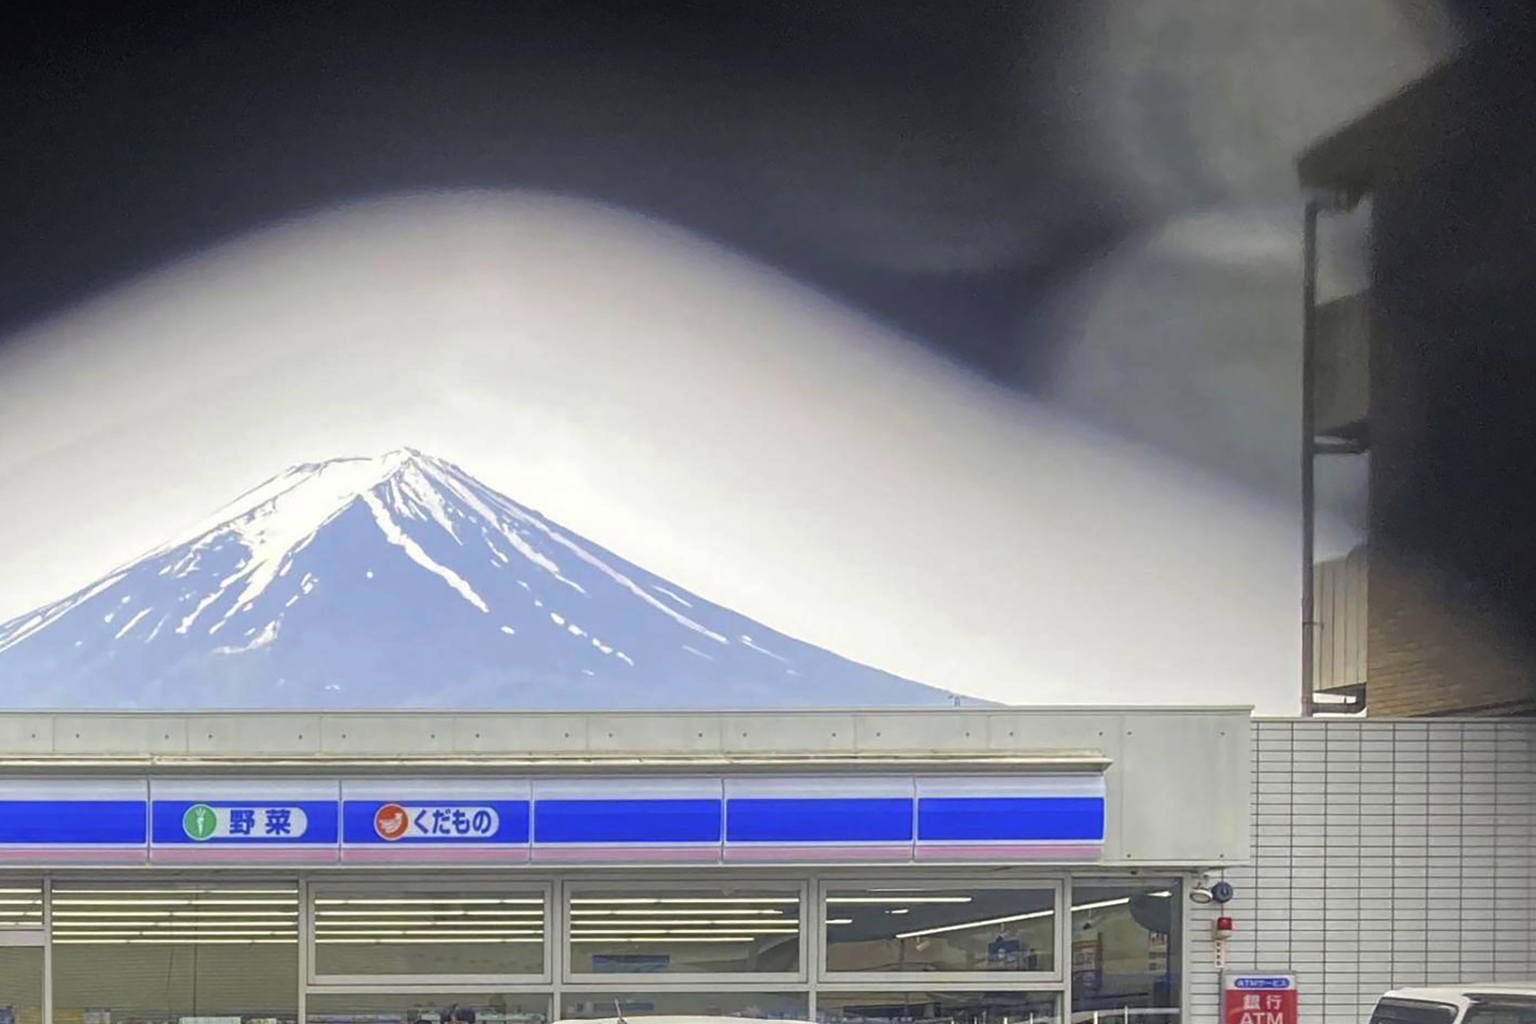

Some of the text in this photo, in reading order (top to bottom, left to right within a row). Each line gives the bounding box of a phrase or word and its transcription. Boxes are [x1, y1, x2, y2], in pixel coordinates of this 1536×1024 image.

[229, 809, 291, 836] 野菜
[413, 808, 492, 835] くだもの
[1243, 994, 1283, 1010] 銀行
